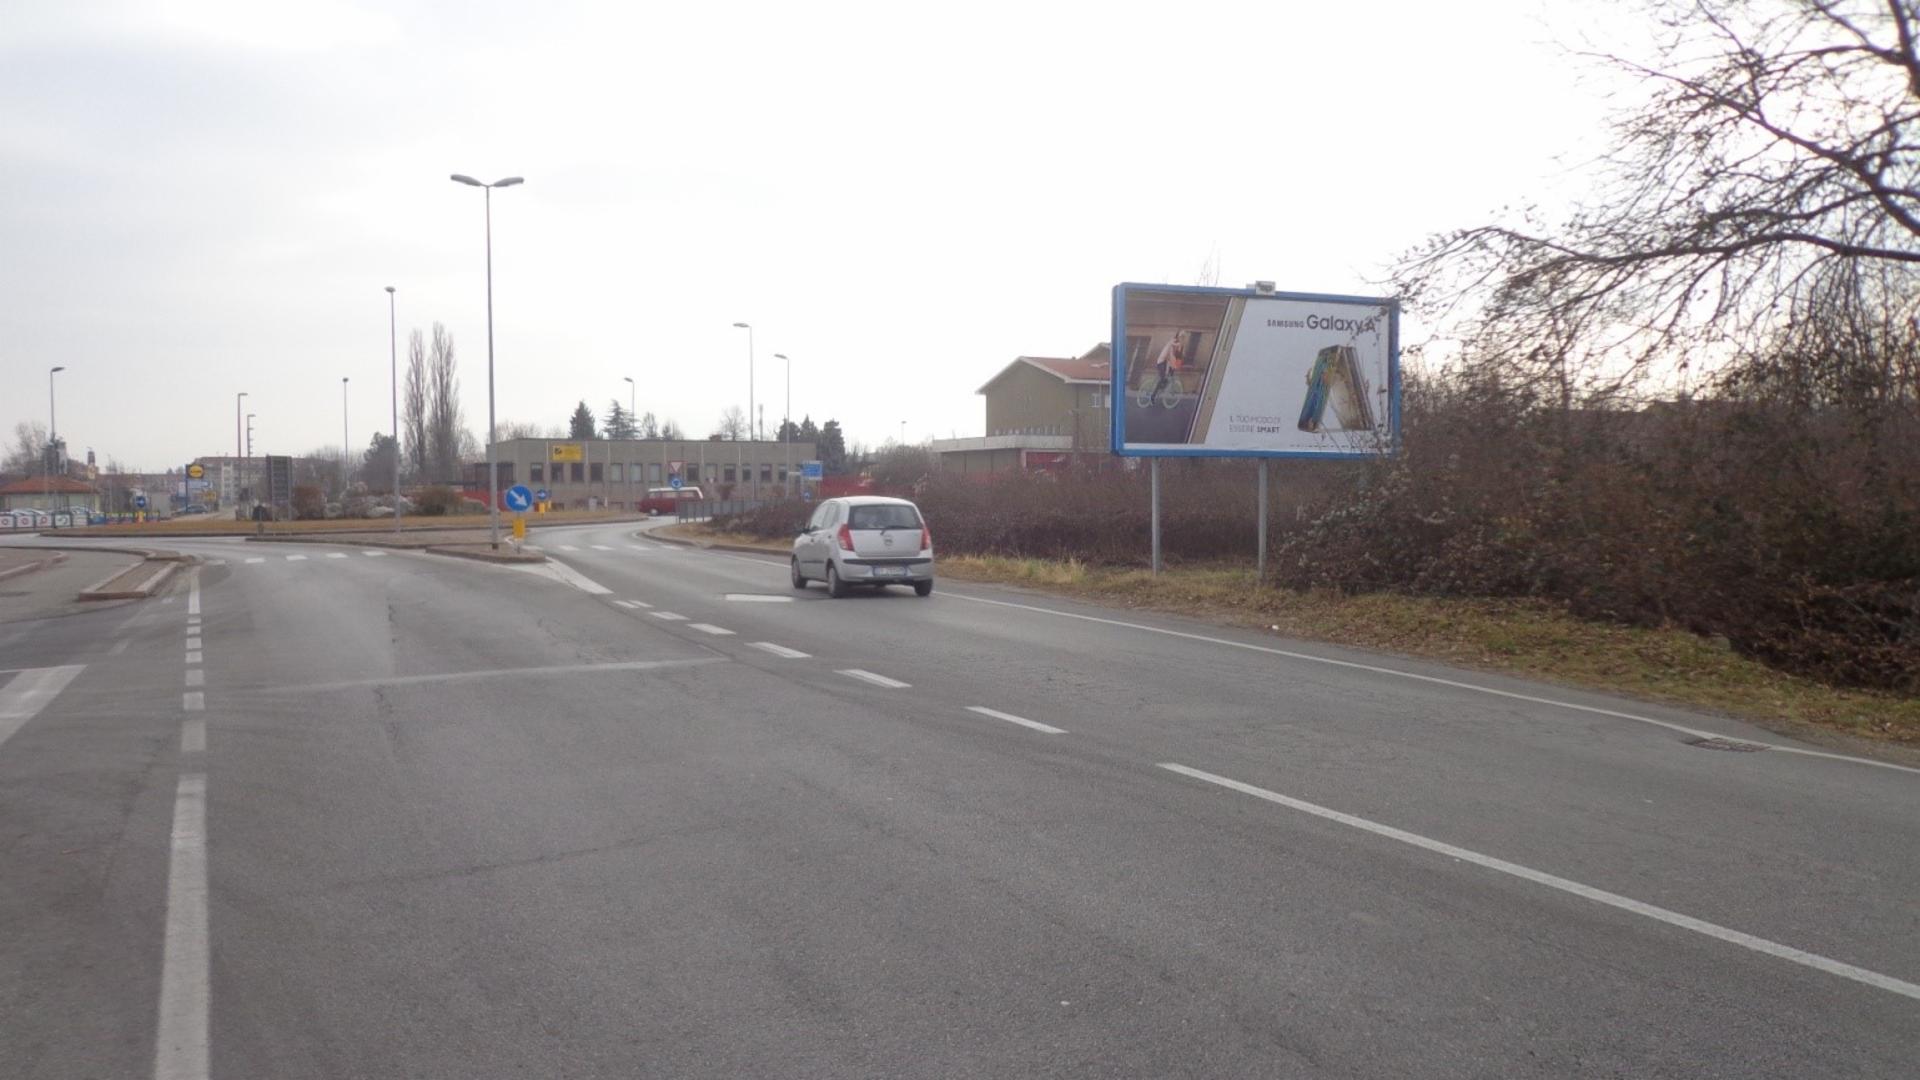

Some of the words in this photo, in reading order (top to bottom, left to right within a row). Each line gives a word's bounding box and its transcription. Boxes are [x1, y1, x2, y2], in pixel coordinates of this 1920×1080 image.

[1267, 319, 1304, 329] SAMSUNG
[1306, 314, 1363, 336] Galaxy
[1257, 426, 1281, 434] SMART
